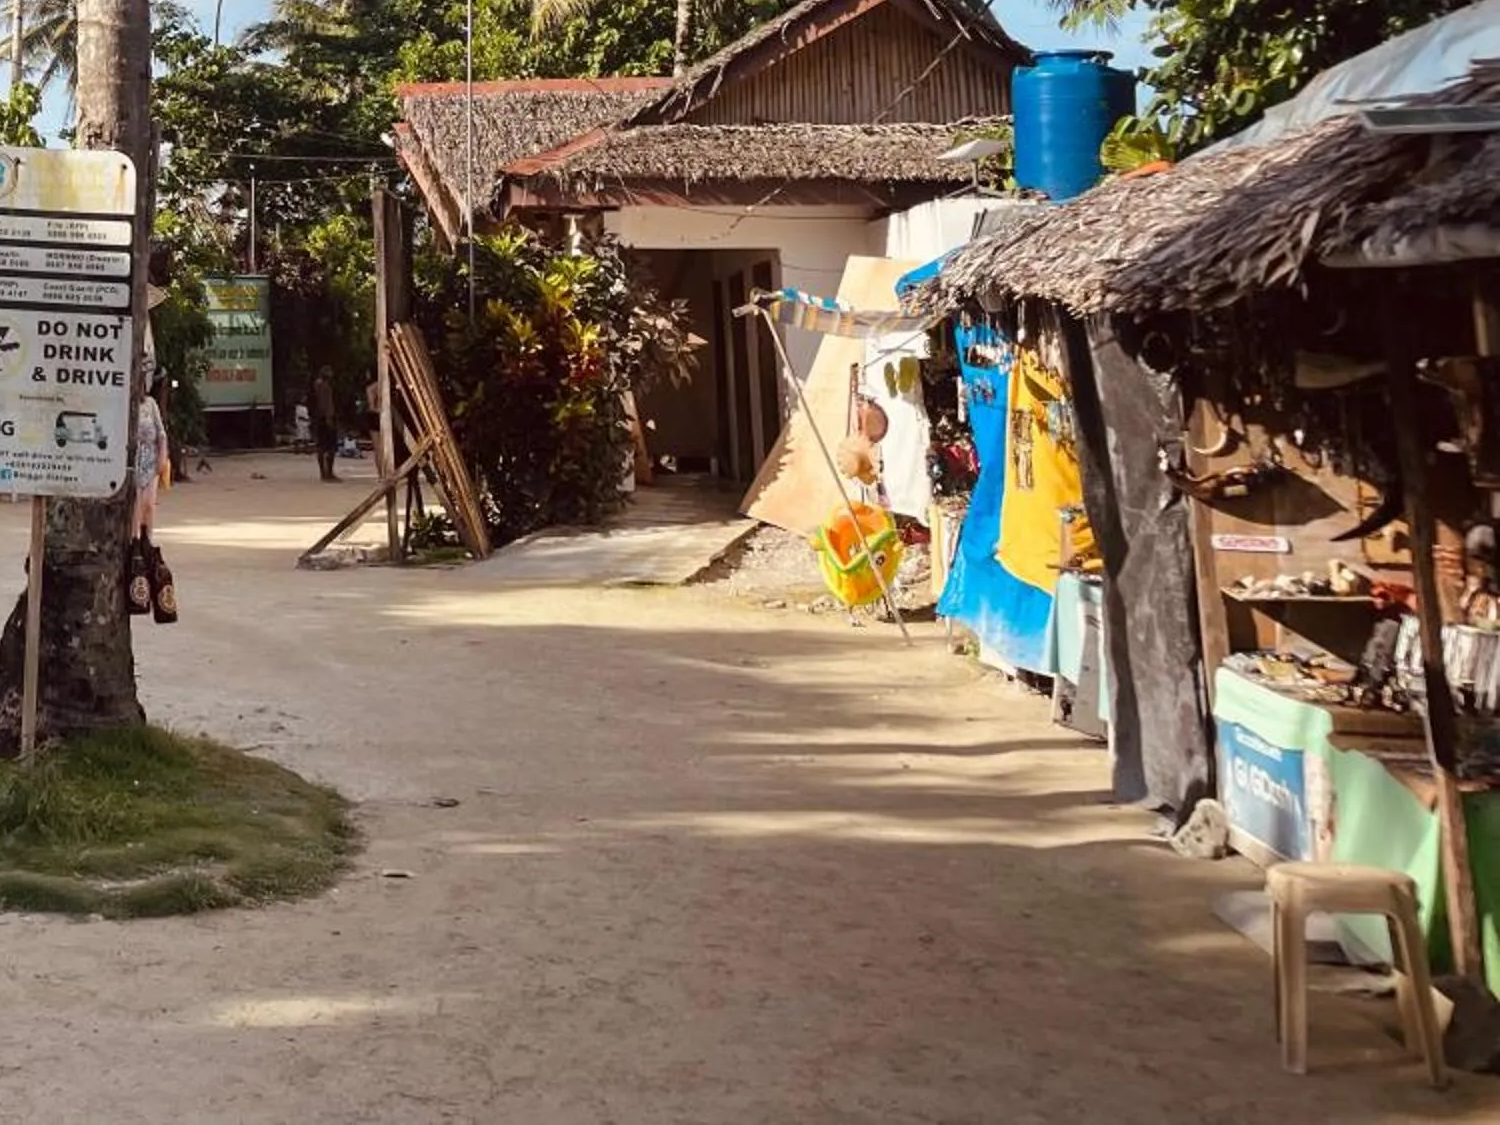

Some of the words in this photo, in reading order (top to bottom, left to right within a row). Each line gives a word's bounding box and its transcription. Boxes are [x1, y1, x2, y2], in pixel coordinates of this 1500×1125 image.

[37, 320, 69, 336] DO
[77, 322, 123, 339] NOT
[43, 344, 115, 363] DRINK
[31, 366, 47, 382] &
[56, 368, 125, 387] DRIVE
